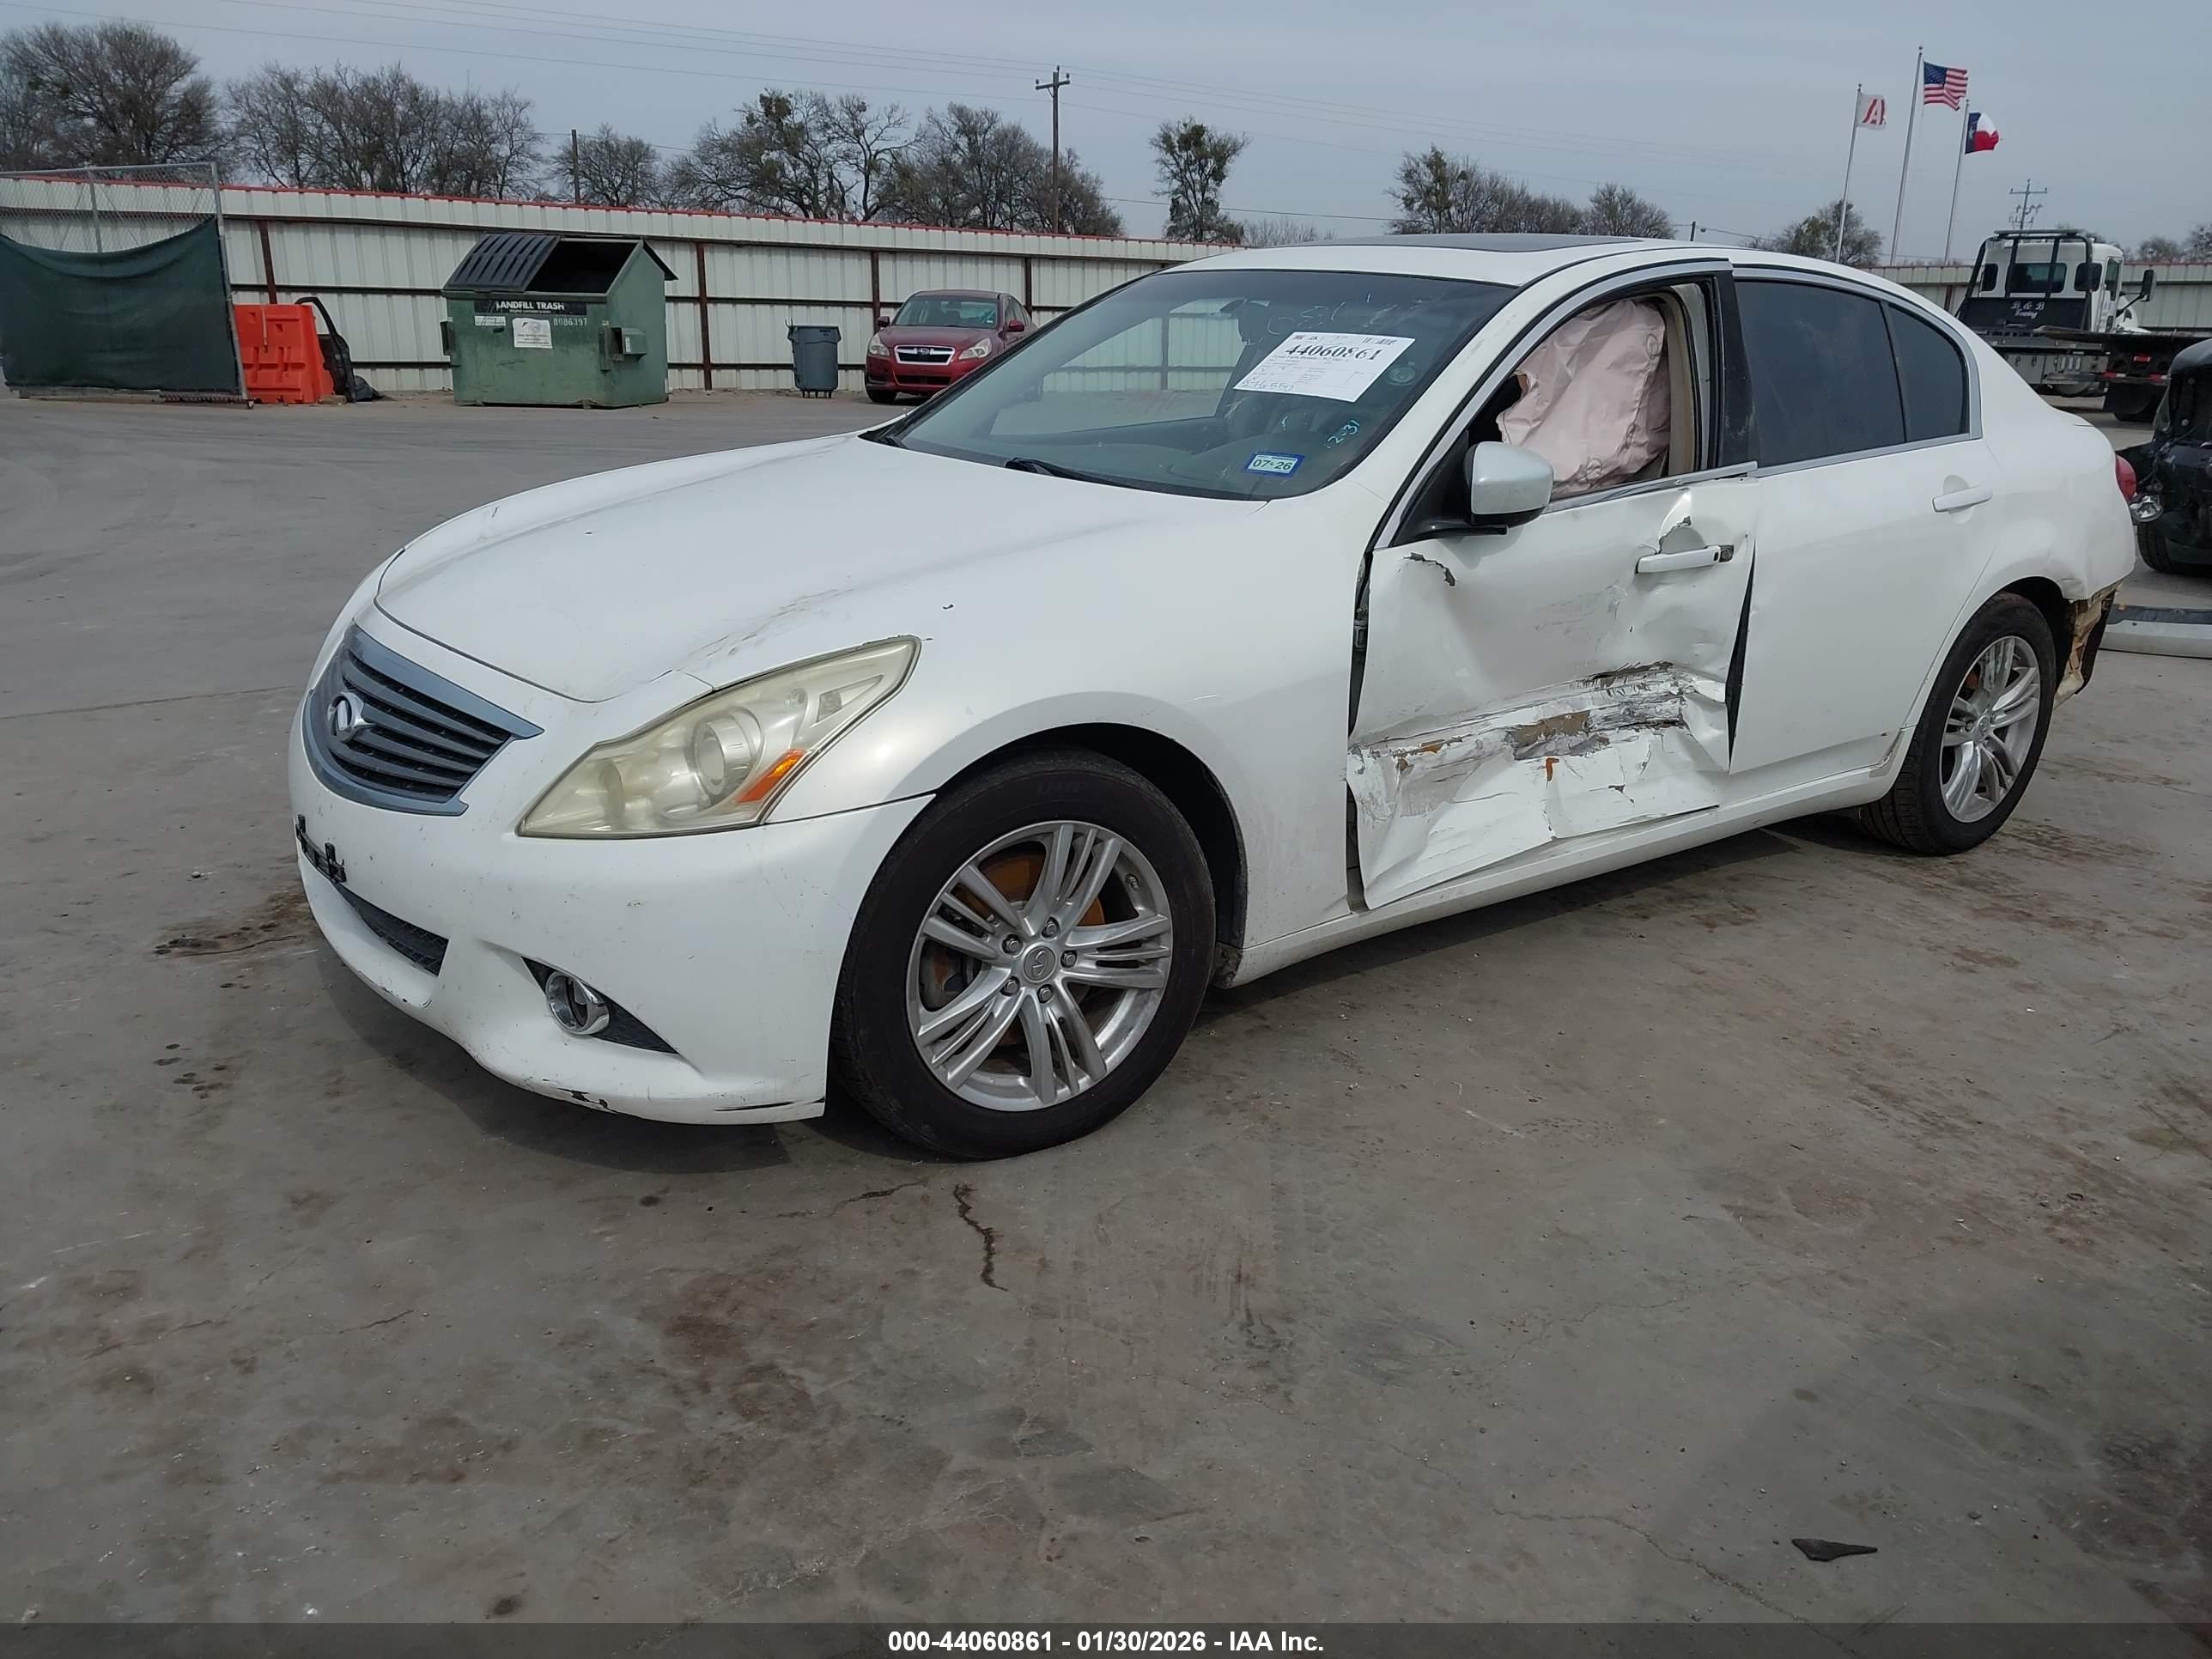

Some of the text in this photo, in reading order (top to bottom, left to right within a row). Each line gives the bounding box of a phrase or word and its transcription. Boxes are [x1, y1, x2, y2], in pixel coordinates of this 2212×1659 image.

[495, 301, 565, 310] LANDFILL TRASH
[1285, 344, 1382, 360] 44060861
